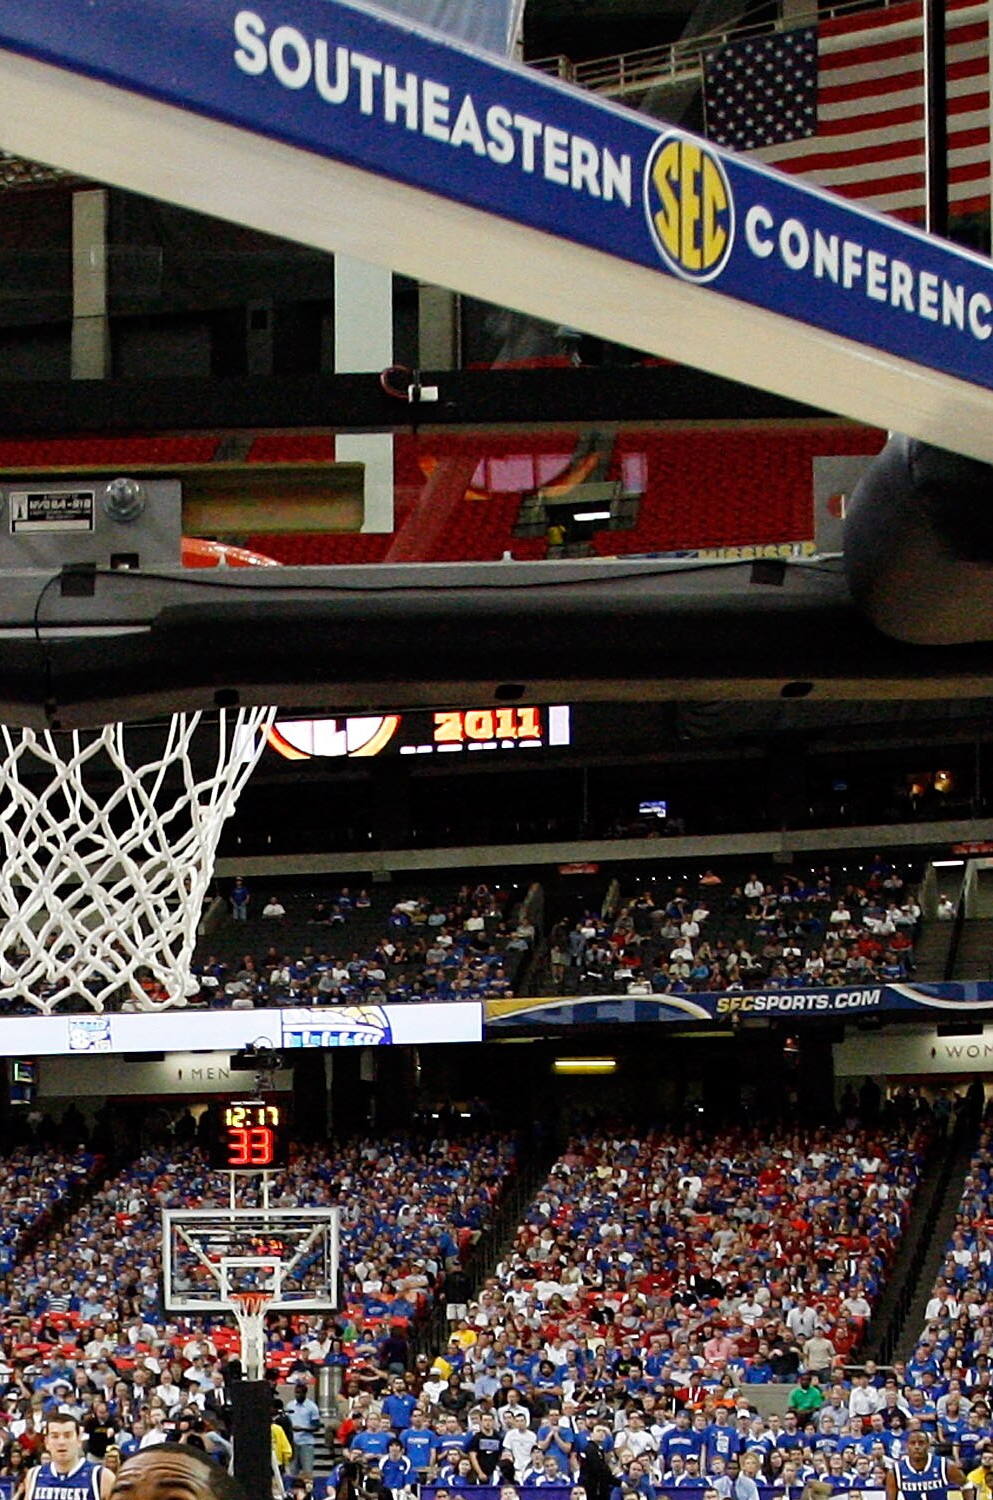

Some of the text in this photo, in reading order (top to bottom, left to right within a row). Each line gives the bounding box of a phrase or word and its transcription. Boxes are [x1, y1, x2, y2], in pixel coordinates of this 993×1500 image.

[234, 10, 993, 340] SOUTHEASTERN SEC CONFERENC
[433, 707, 541, 741] 2011
[716, 989, 880, 1013] SECSPORTS.COM
[191, 1066, 230, 1079] MEN
[225, 1106, 279, 1127] 12:17
[228, 1128, 273, 1164] 33
[34, 1486, 89, 1500] KENTUCKY
[901, 1480, 943, 1491] KENTUCKY
